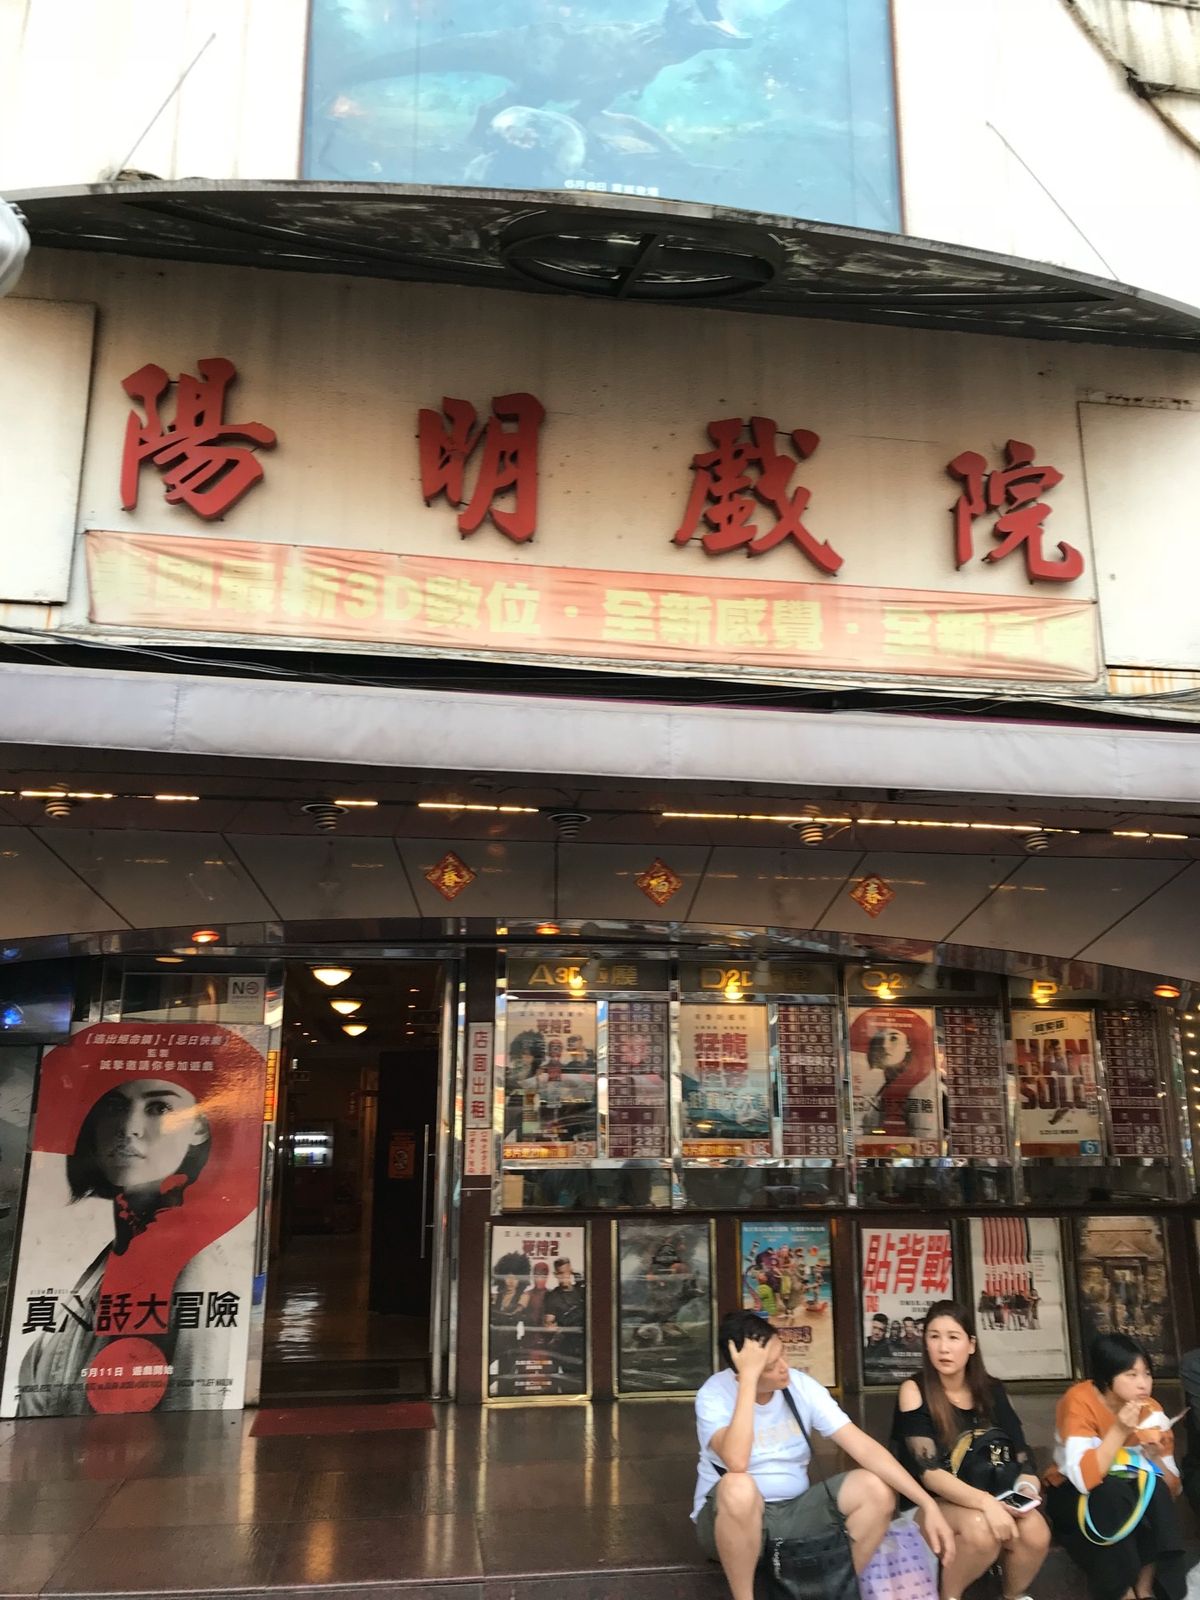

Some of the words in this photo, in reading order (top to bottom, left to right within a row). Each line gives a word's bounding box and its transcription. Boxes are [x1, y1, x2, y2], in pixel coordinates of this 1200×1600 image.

[22, 1291, 240, 1334] 真心話大冒險
